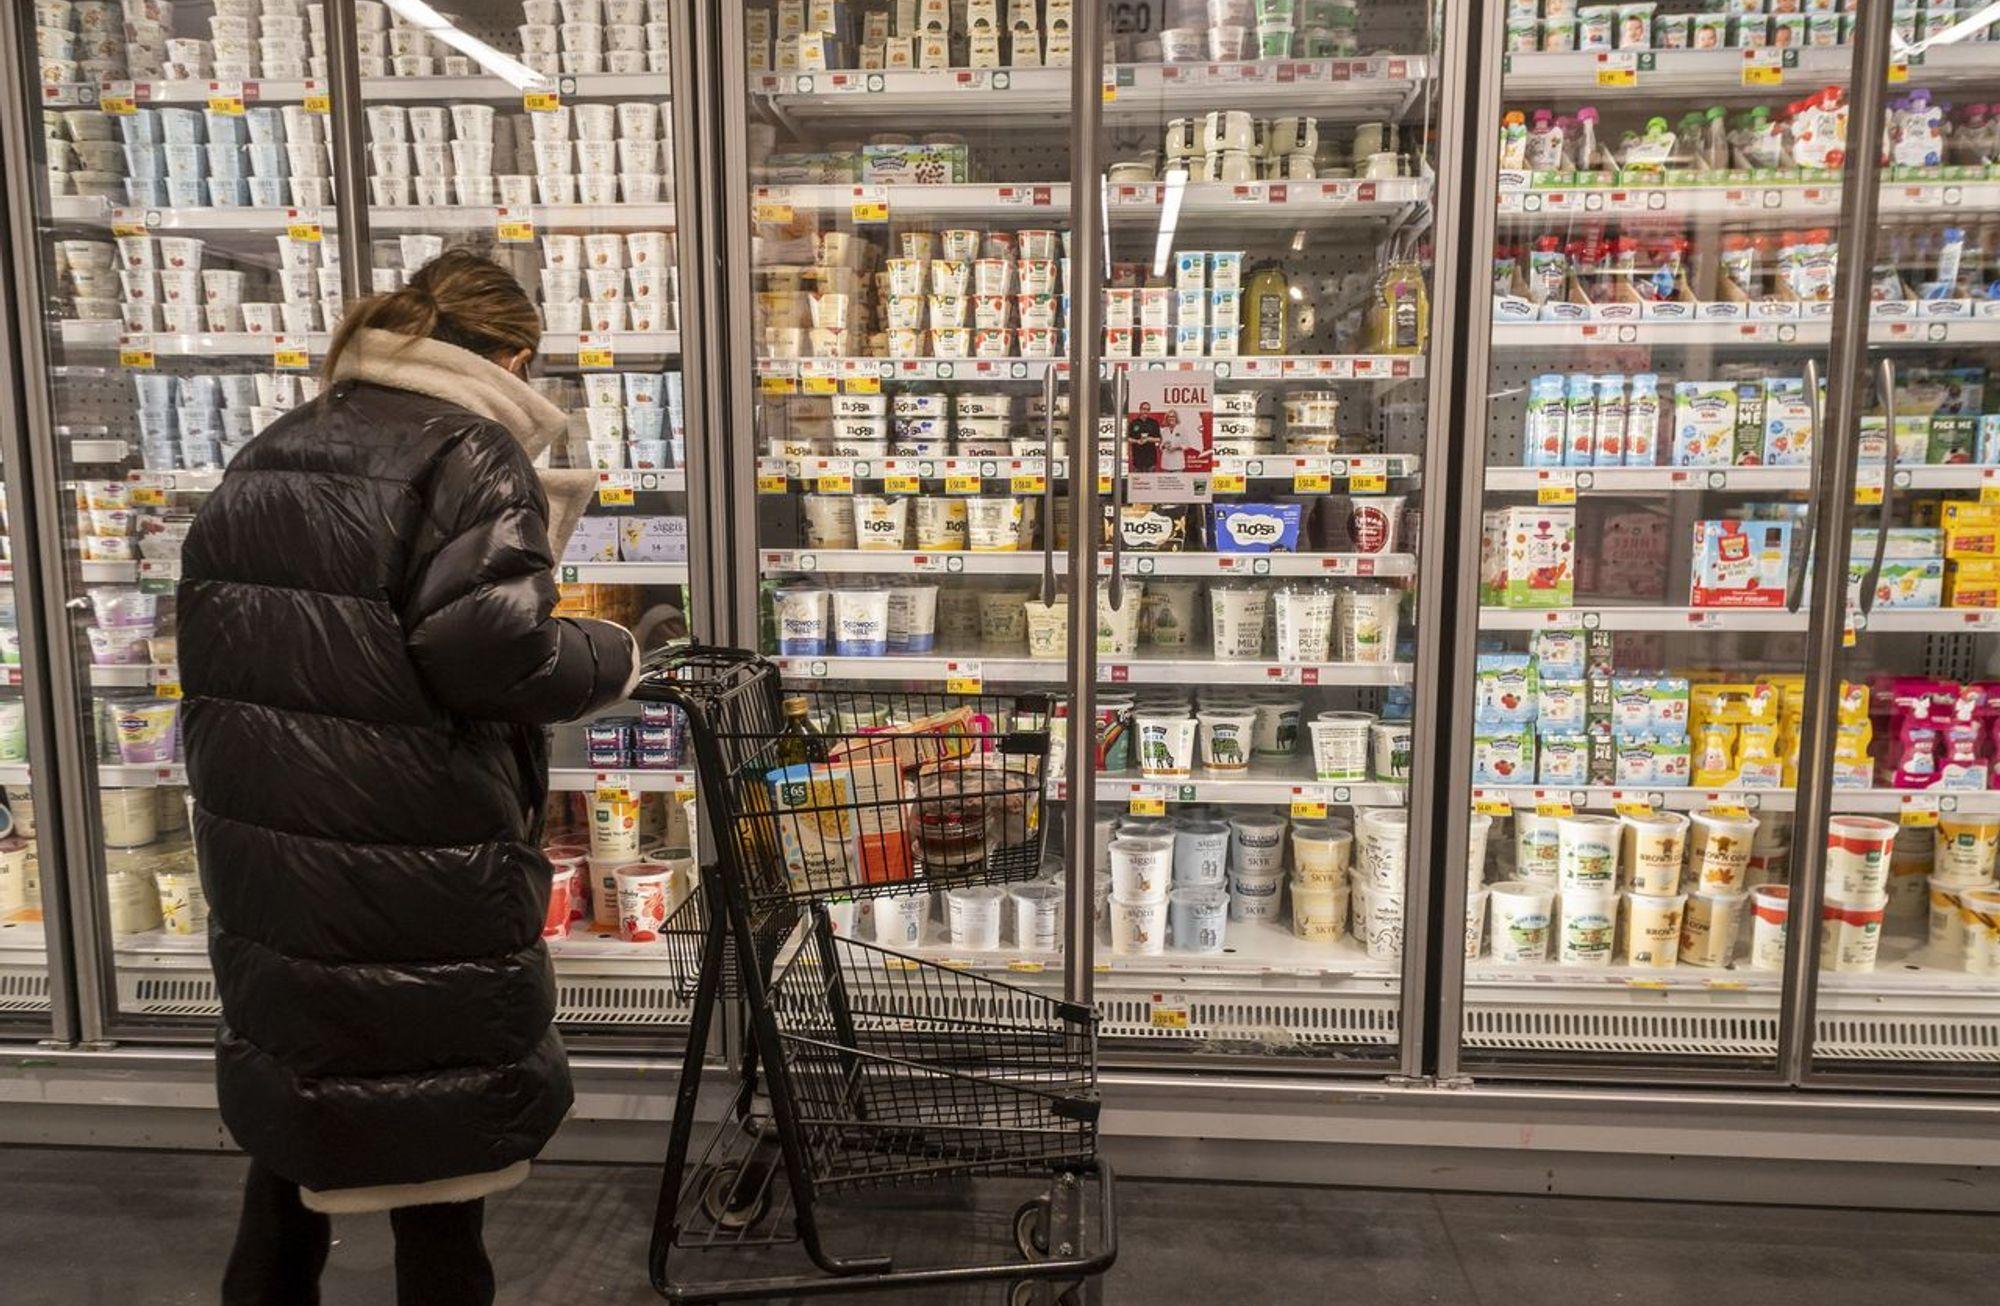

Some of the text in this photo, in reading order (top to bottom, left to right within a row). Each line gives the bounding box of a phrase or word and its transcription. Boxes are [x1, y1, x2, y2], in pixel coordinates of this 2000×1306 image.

[1164, 387, 1208, 404] LOCAL
[1739, 413, 1761, 425] ME
[864, 519, 895, 533] noosa
[1124, 520, 1163, 535] noosa
[1237, 521, 1276, 535] noosa
